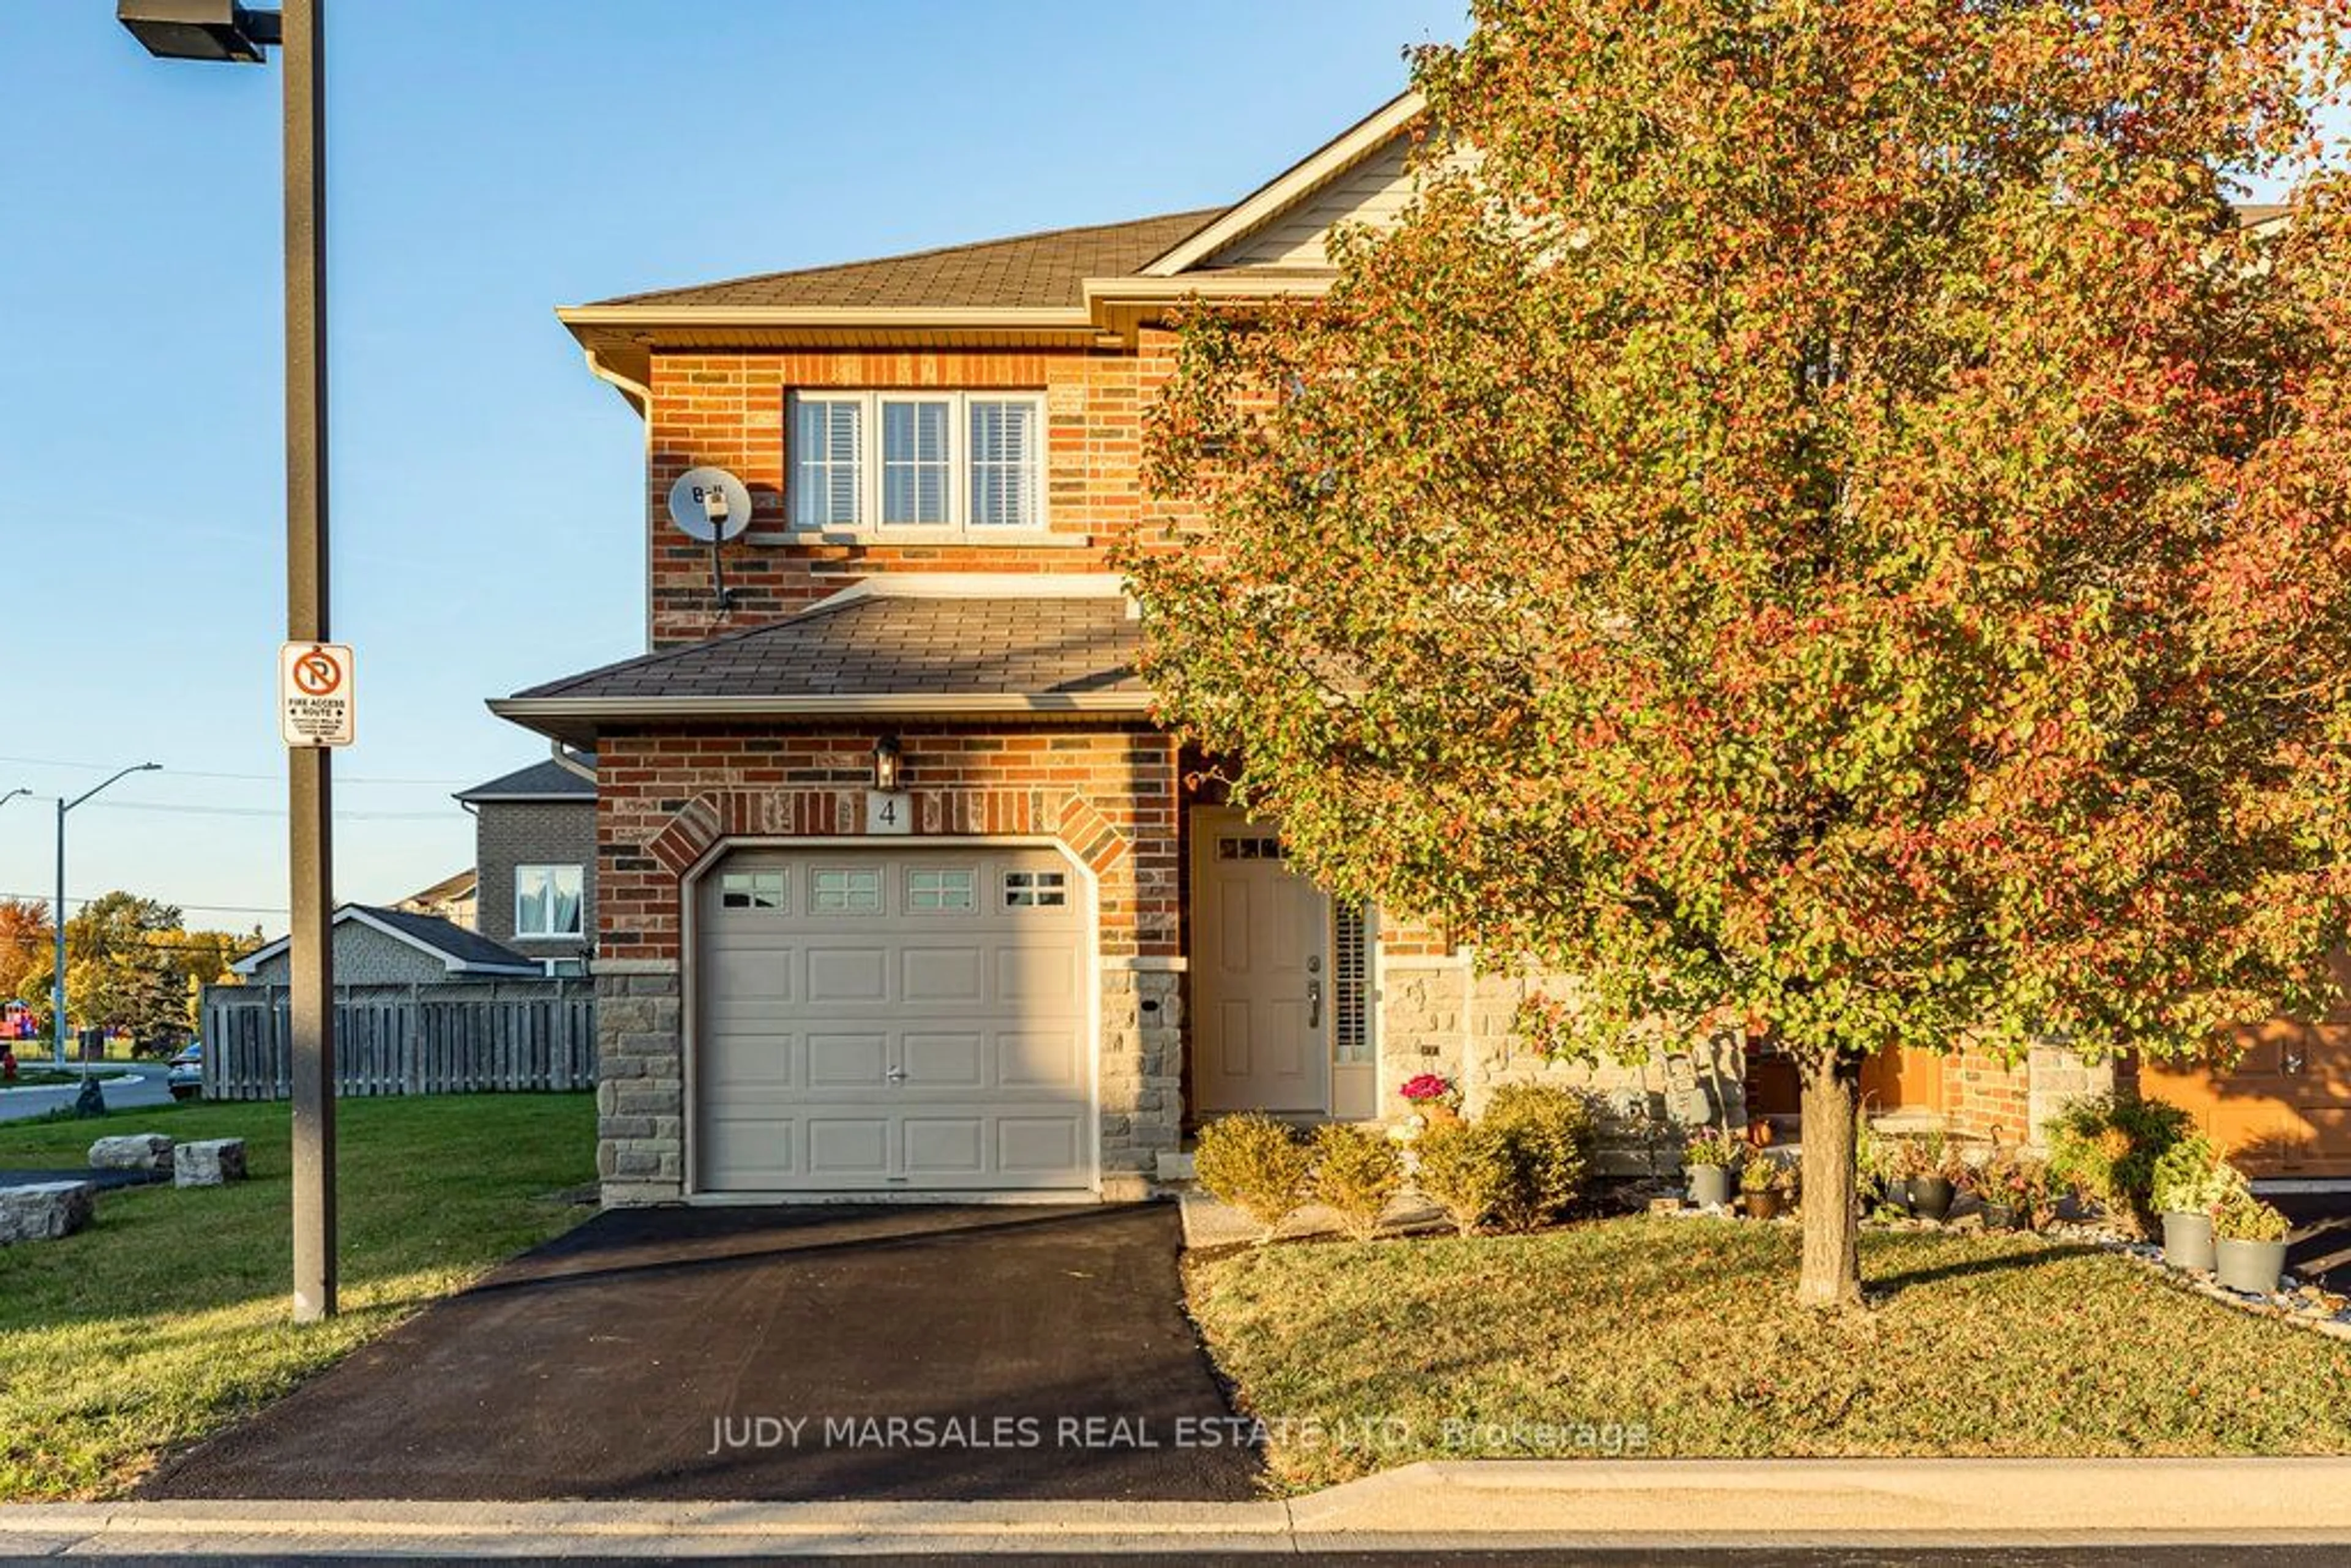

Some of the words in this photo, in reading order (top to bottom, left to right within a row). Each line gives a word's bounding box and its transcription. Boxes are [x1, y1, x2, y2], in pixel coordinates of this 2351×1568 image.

[288, 698, 307, 707] FIRE
[310, 699, 345, 708] ACCESS
[302, 707, 331, 717] ROUTE
[879, 800, 896, 826] 4
